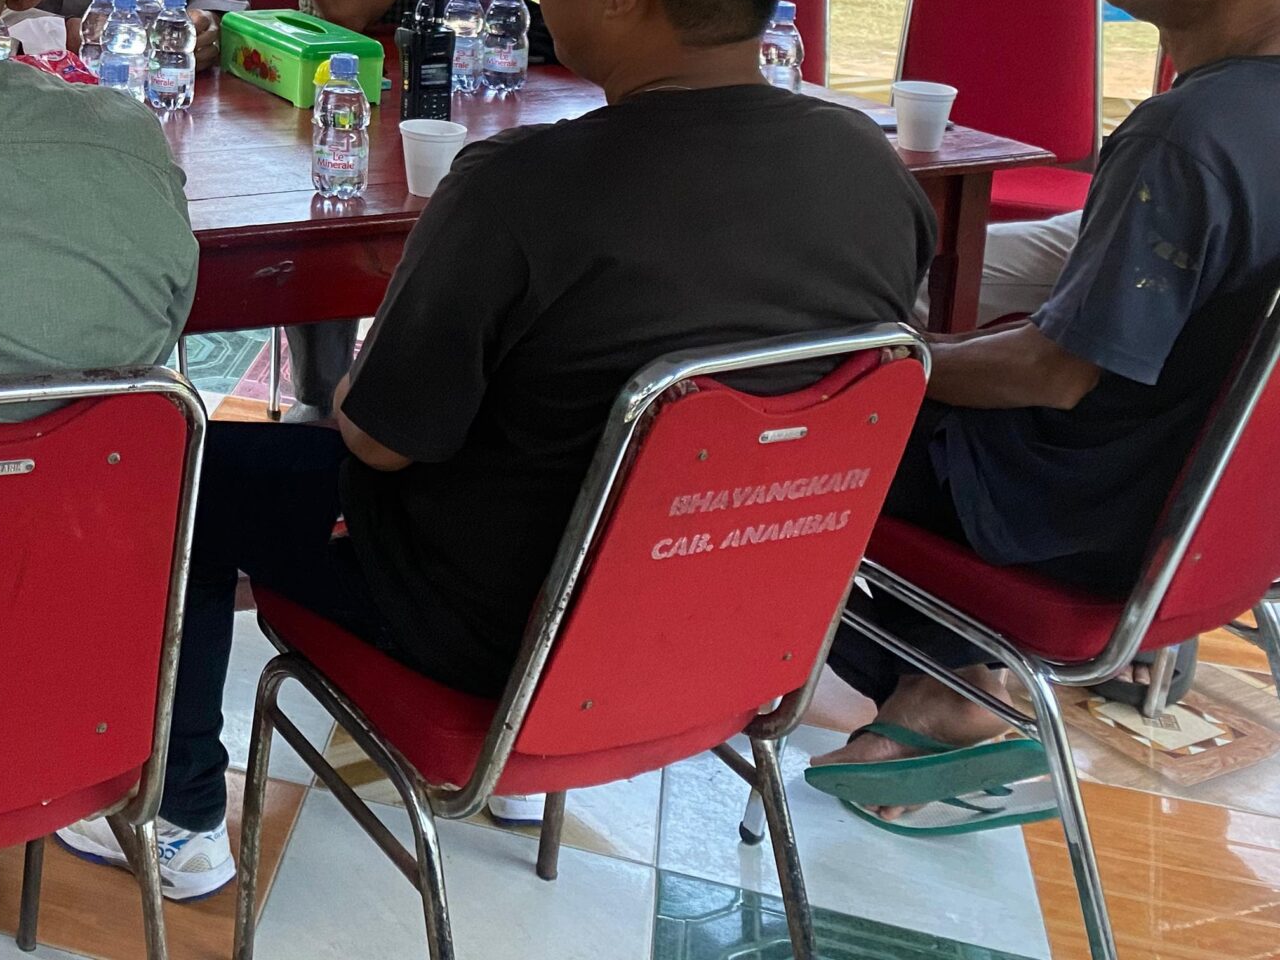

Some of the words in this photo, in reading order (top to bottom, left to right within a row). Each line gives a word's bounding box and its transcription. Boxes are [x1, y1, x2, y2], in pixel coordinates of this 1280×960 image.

[332, 151, 344, 161] Le
[317, 157, 355, 170] Minerale
[651, 533, 714, 560] CAB.
[720, 509, 852, 550] ANAMBAS
